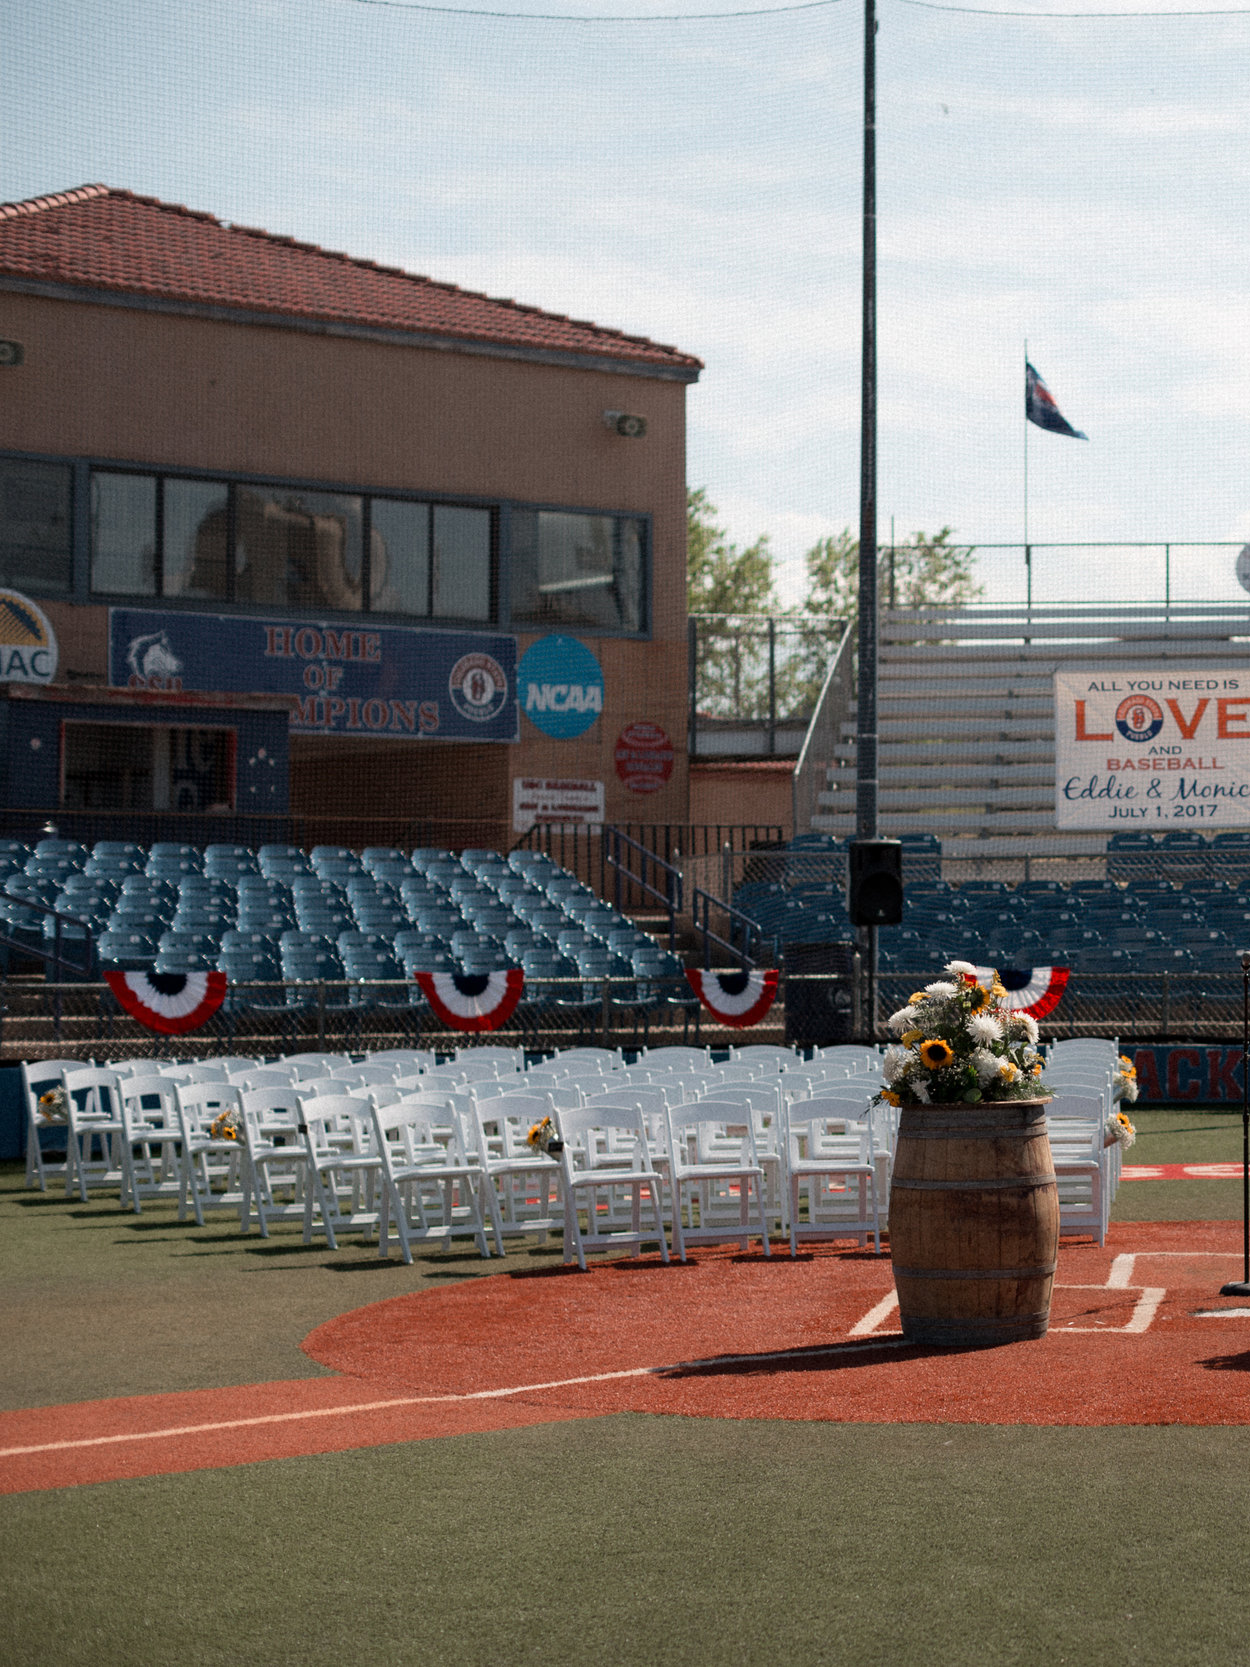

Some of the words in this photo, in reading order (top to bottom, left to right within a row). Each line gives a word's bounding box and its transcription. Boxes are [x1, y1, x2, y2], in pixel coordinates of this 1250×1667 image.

[264, 626, 381, 662] HOME
[0, 648, 50, 677] AC
[303, 664, 343, 690] OF
[1088, 681, 1123, 692] ALL
[1127, 680, 1163, 691] YOU
[1168, 679, 1219, 690] NEED
[1223, 679, 1240, 690] IS
[525, 683, 602, 713] NCAA
[289, 695, 440, 731] MPIONS
[1148, 746, 1182, 755] AND
[1107, 758, 1225, 771] BASEBALL
[1062, 775, 1139, 801] Eddie
[1147, 778, 1162, 798] &
[1108, 805, 1149, 818] JULY
[1156, 805, 1169, 819] 1,
[1173, 805, 1218, 817] 2017
[1119, 1048, 1245, 1100] ACK
